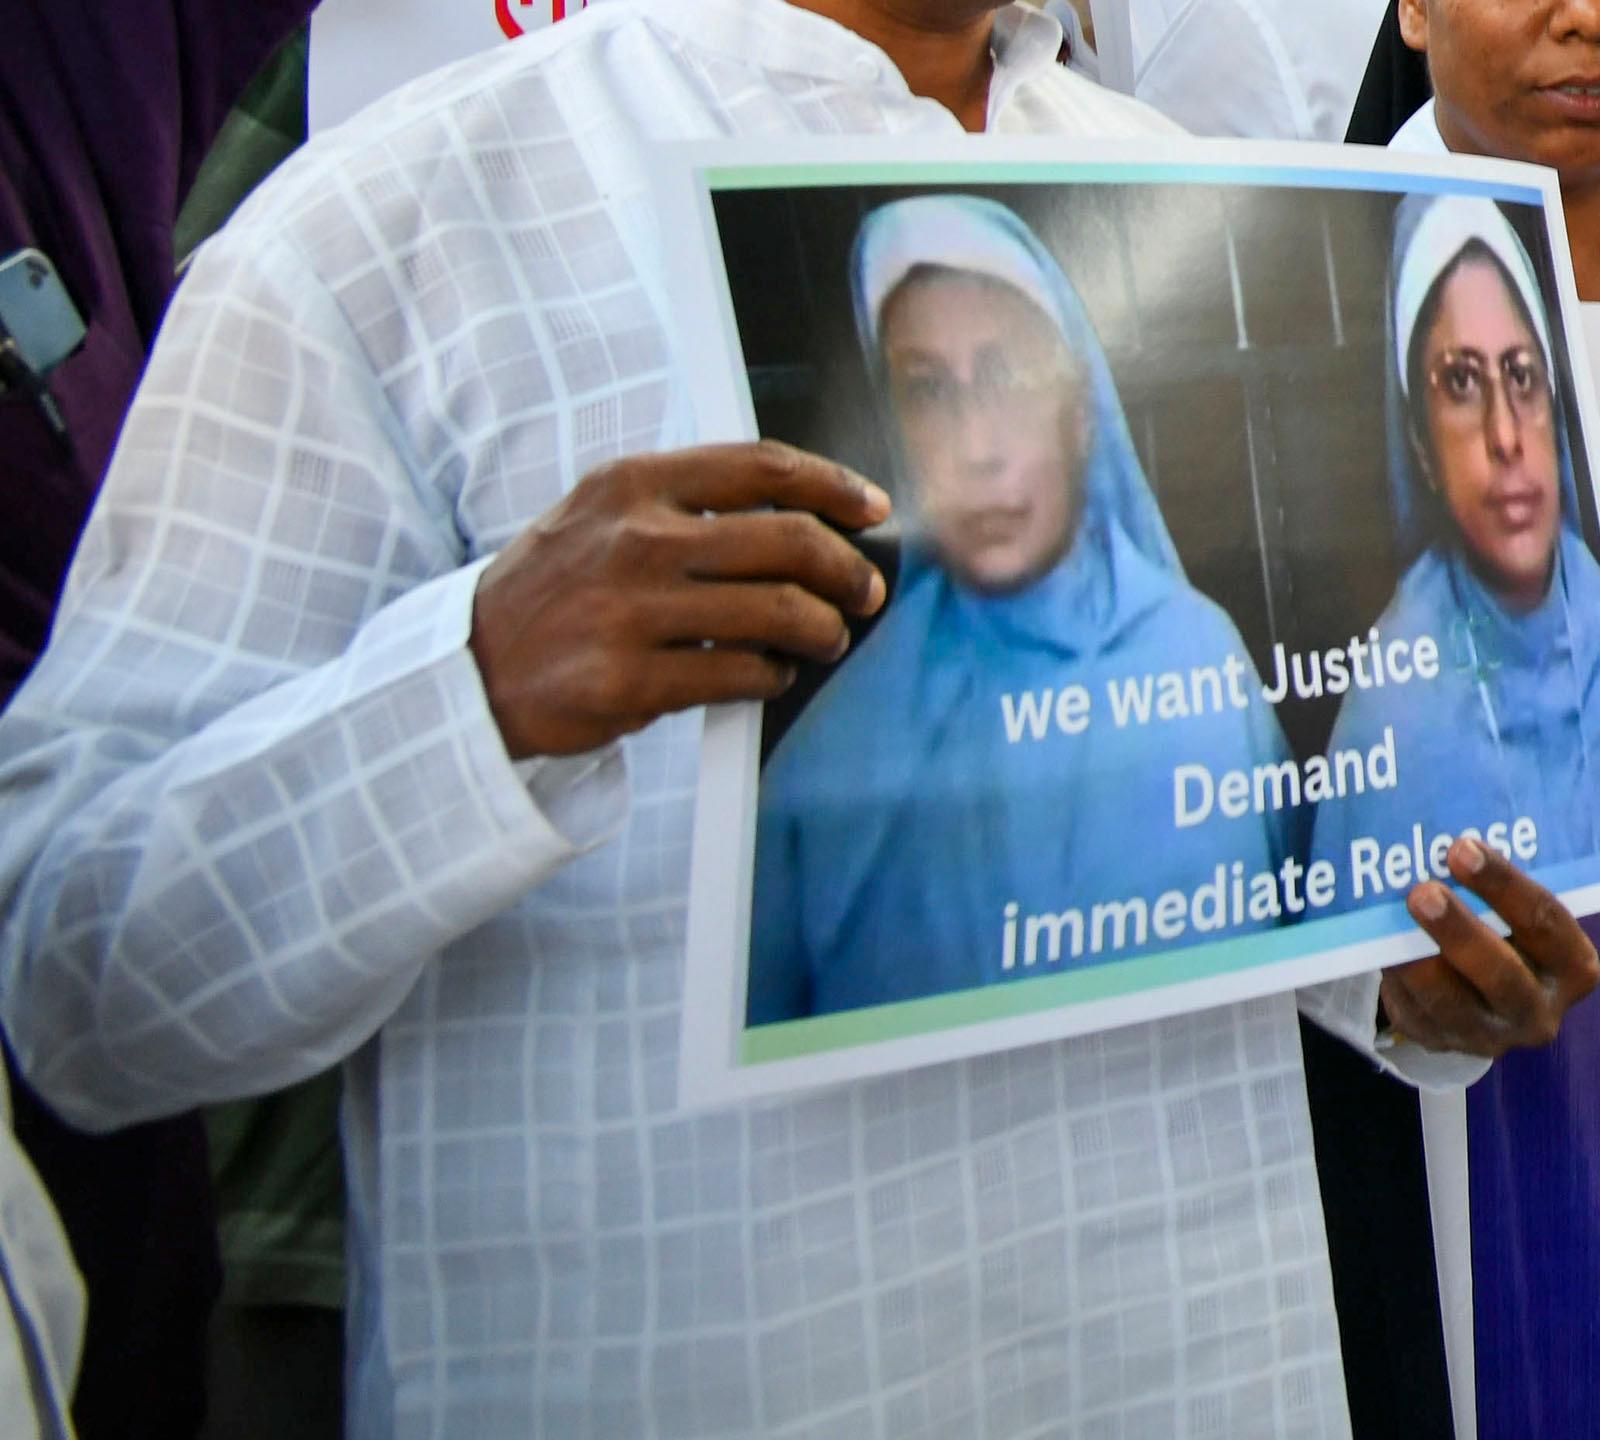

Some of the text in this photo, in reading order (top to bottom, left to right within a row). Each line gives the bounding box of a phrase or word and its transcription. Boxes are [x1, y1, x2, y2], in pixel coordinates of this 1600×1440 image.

[1106, 653, 1250, 729] want
[1261, 627, 1440, 704] Justice
[1173, 724, 1398, 829] Demand
[1001, 857, 1336, 971] immediate
